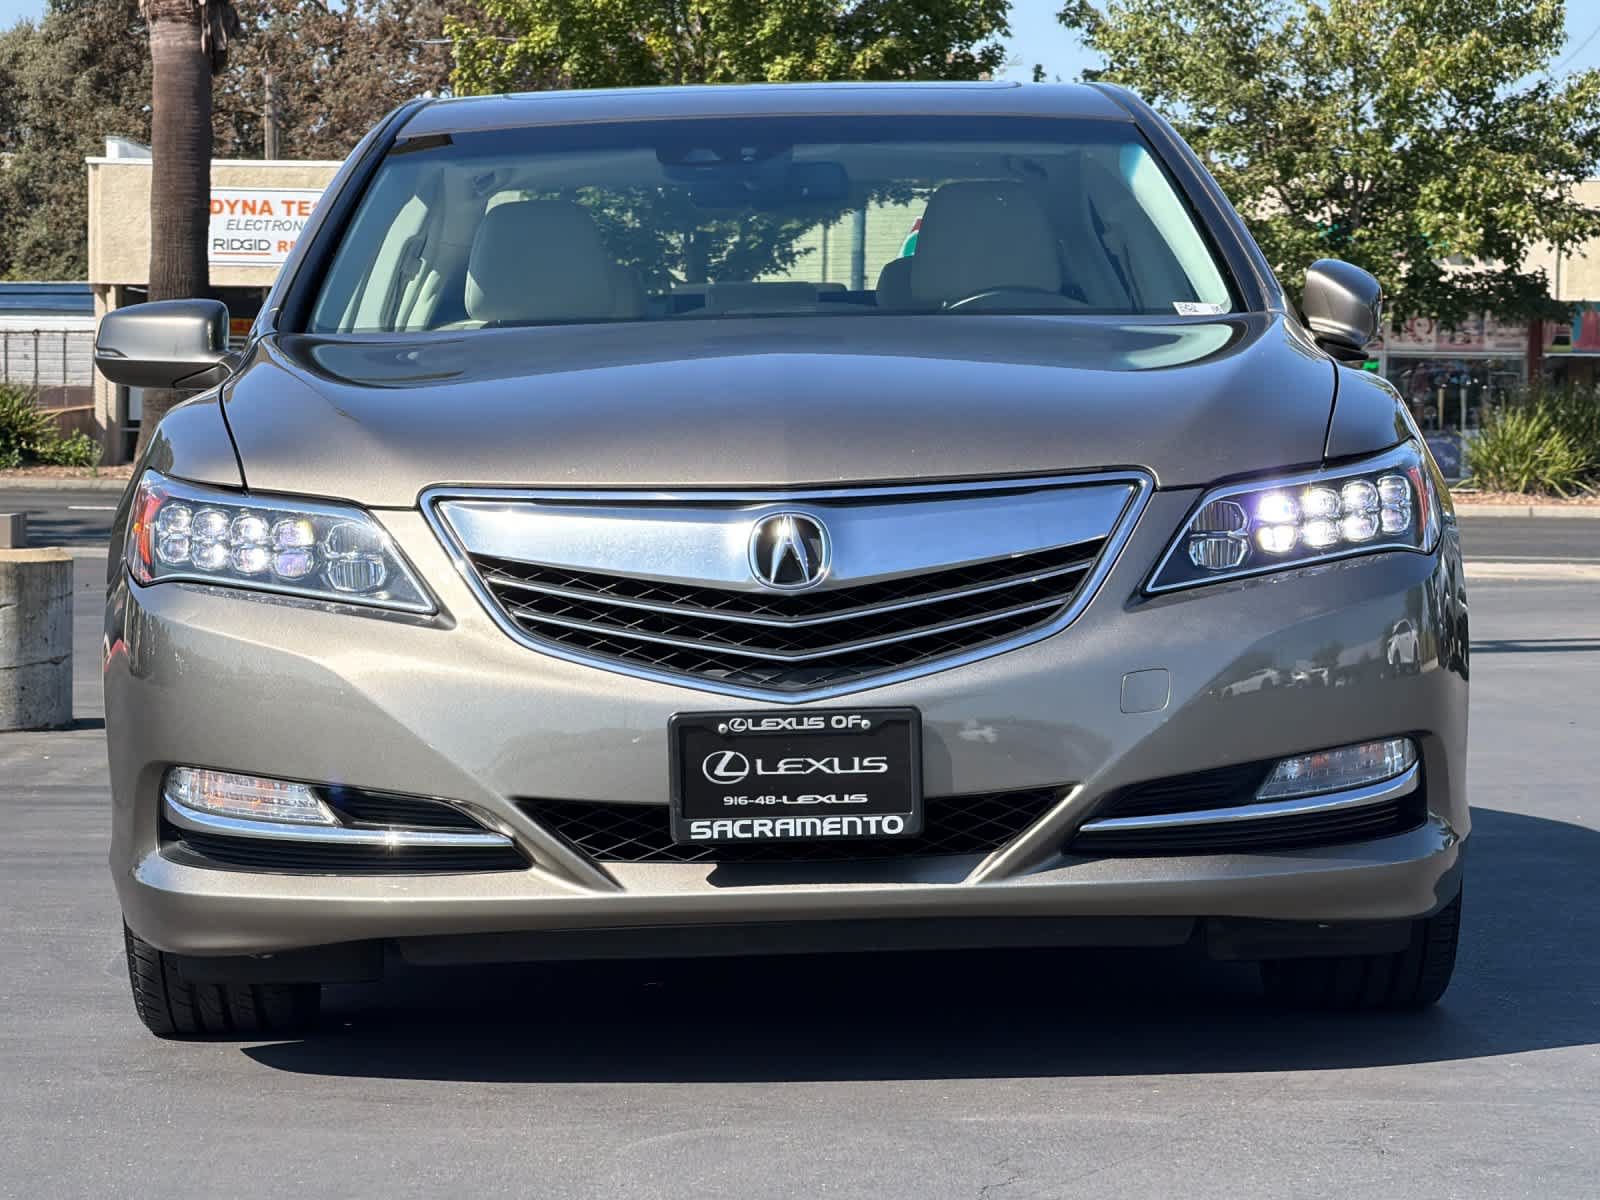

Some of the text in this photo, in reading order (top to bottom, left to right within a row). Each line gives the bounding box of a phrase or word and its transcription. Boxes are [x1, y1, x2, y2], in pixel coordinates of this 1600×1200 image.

[210, 200, 317, 216] DYNA TE
[213, 239, 271, 251] RIDGID
[748, 715, 861, 731] LEXUS OF
[756, 757, 888, 775] LEXUS
[723, 794, 868, 806] 916-48-LEXUS
[690, 816, 904, 839] SACRAMENTO
